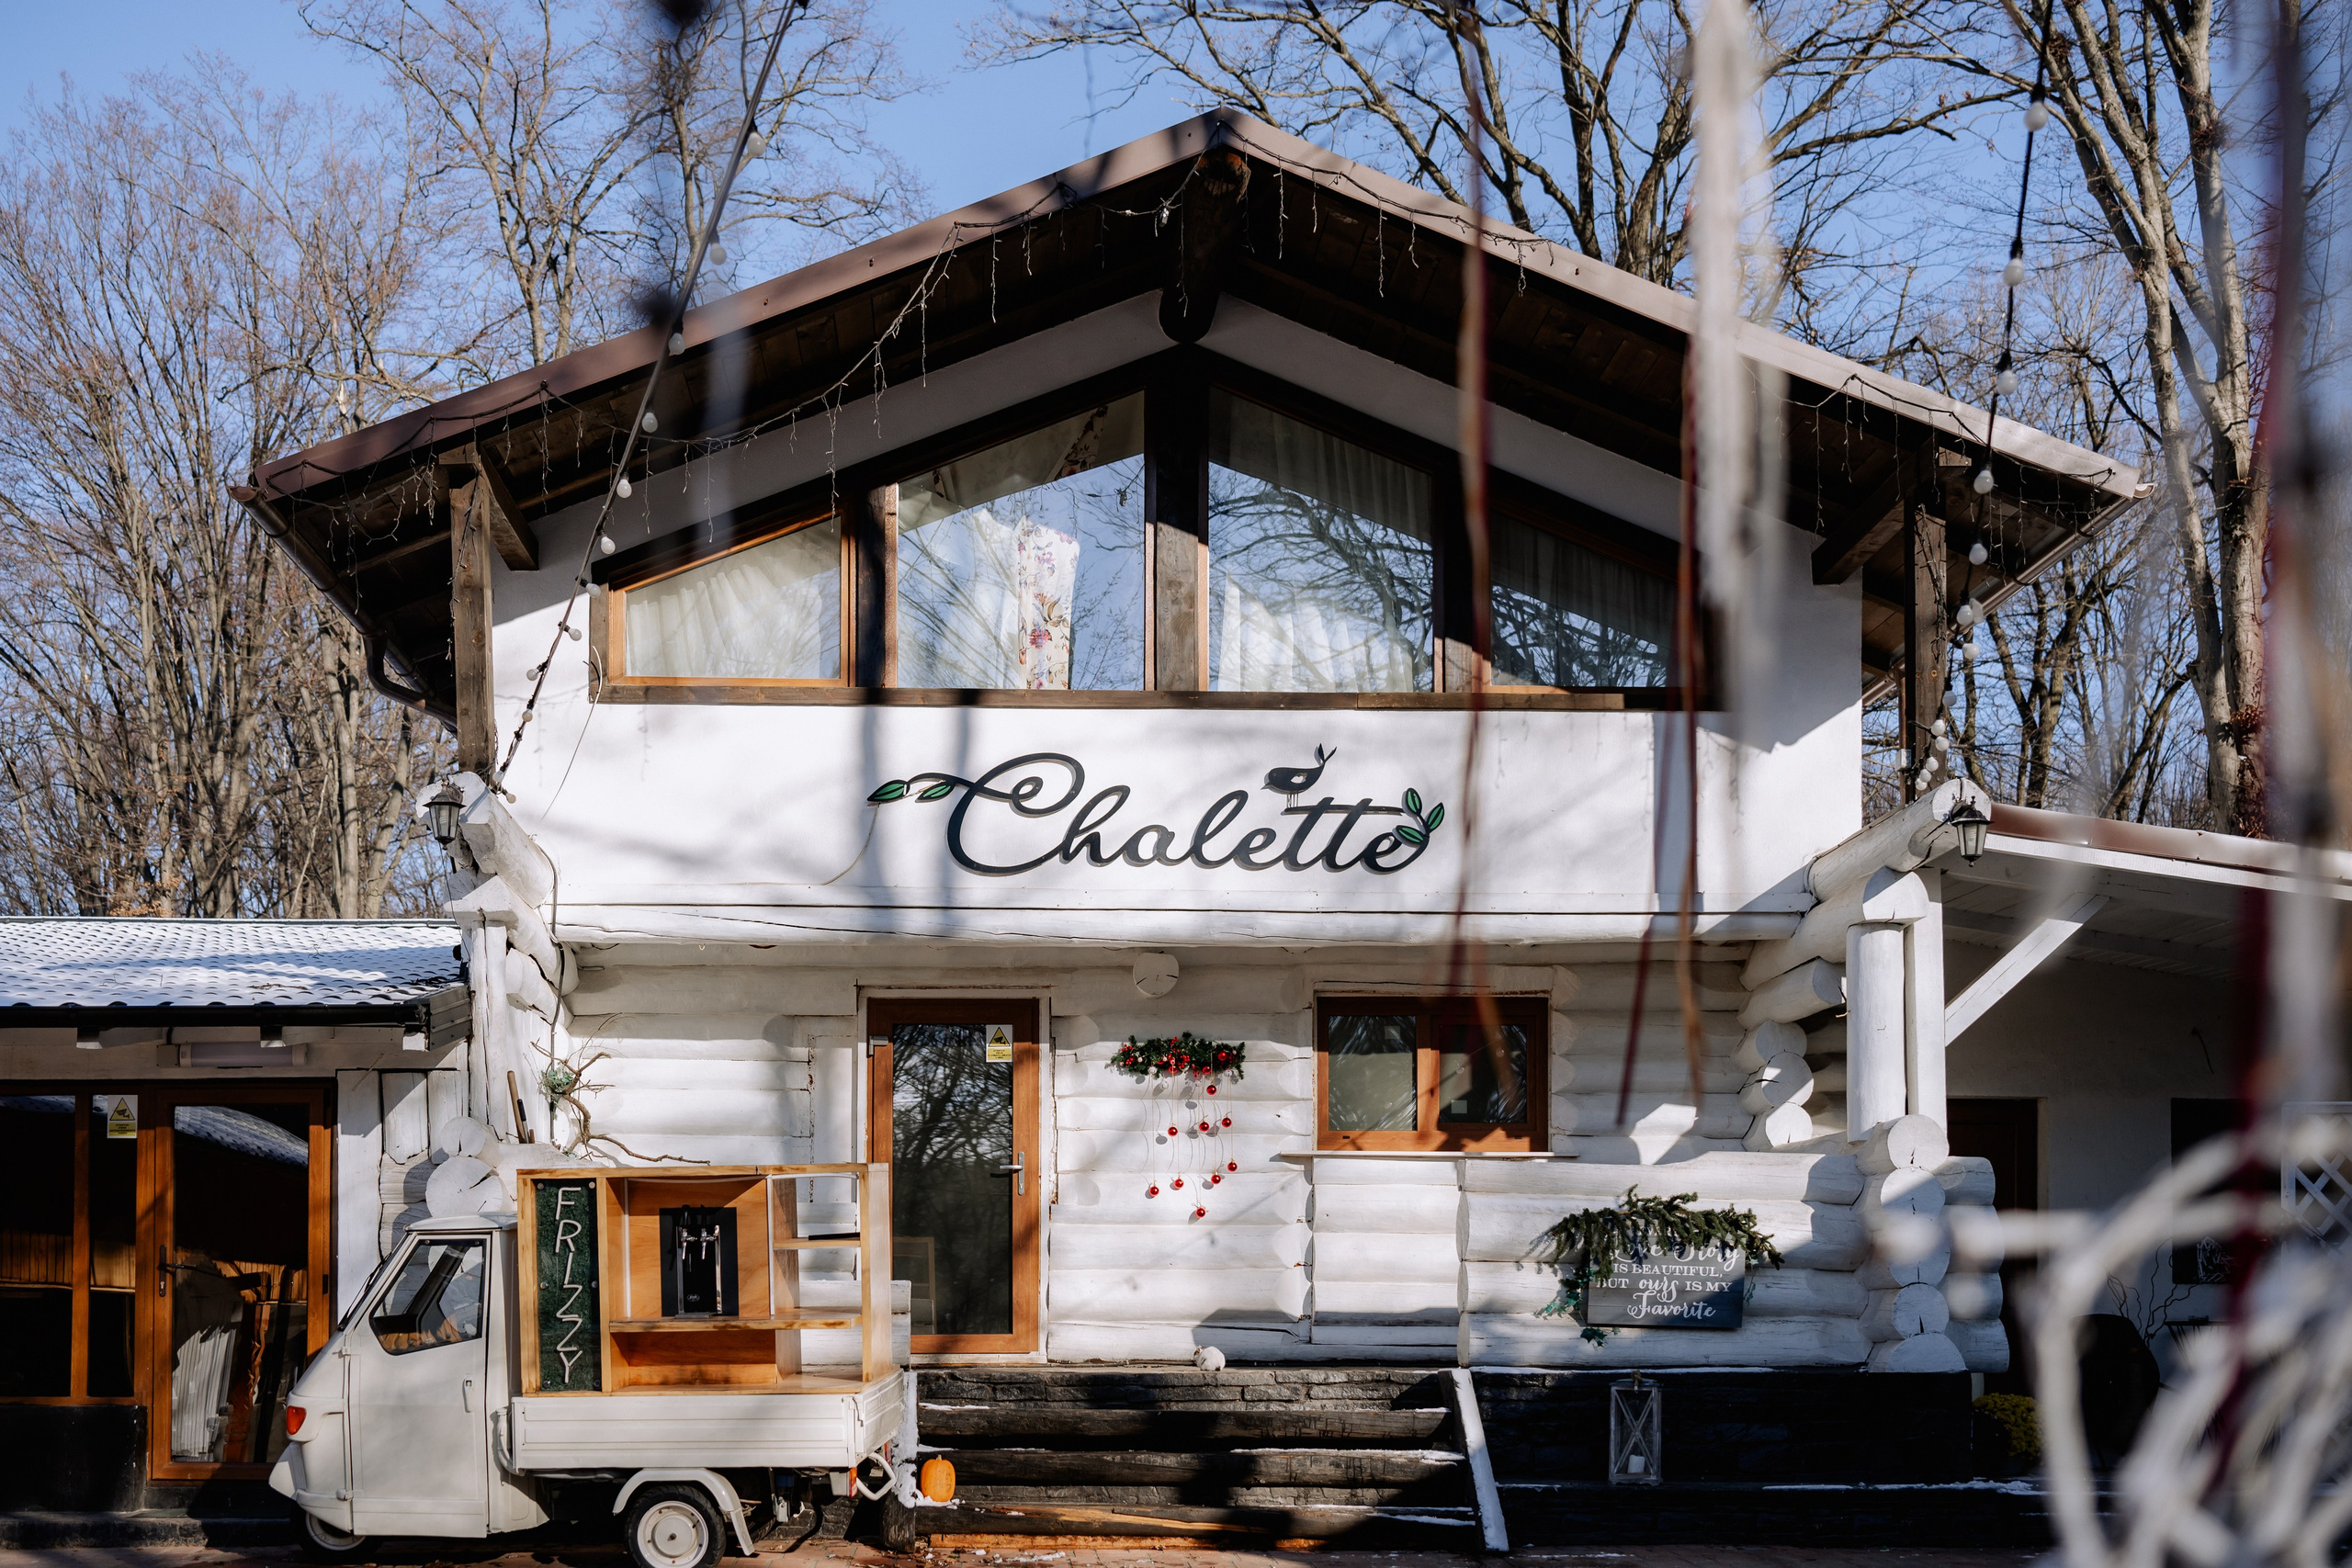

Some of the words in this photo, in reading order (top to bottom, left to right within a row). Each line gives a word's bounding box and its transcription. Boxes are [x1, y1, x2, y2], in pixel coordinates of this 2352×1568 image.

[905, 751, 1431, 877] Chalette
[555, 1186, 583, 1384] FRIZZY
[1613, 1263, 1628, 1273] IS
[1632, 1264, 1723, 1278] BEAUTIFUL,
[1638, 1276, 1679, 1303] ours
[1685, 1280, 1702, 1292] IS
[1705, 1281, 1733, 1292] MY
[1627, 1290, 1715, 1320] Favorite
